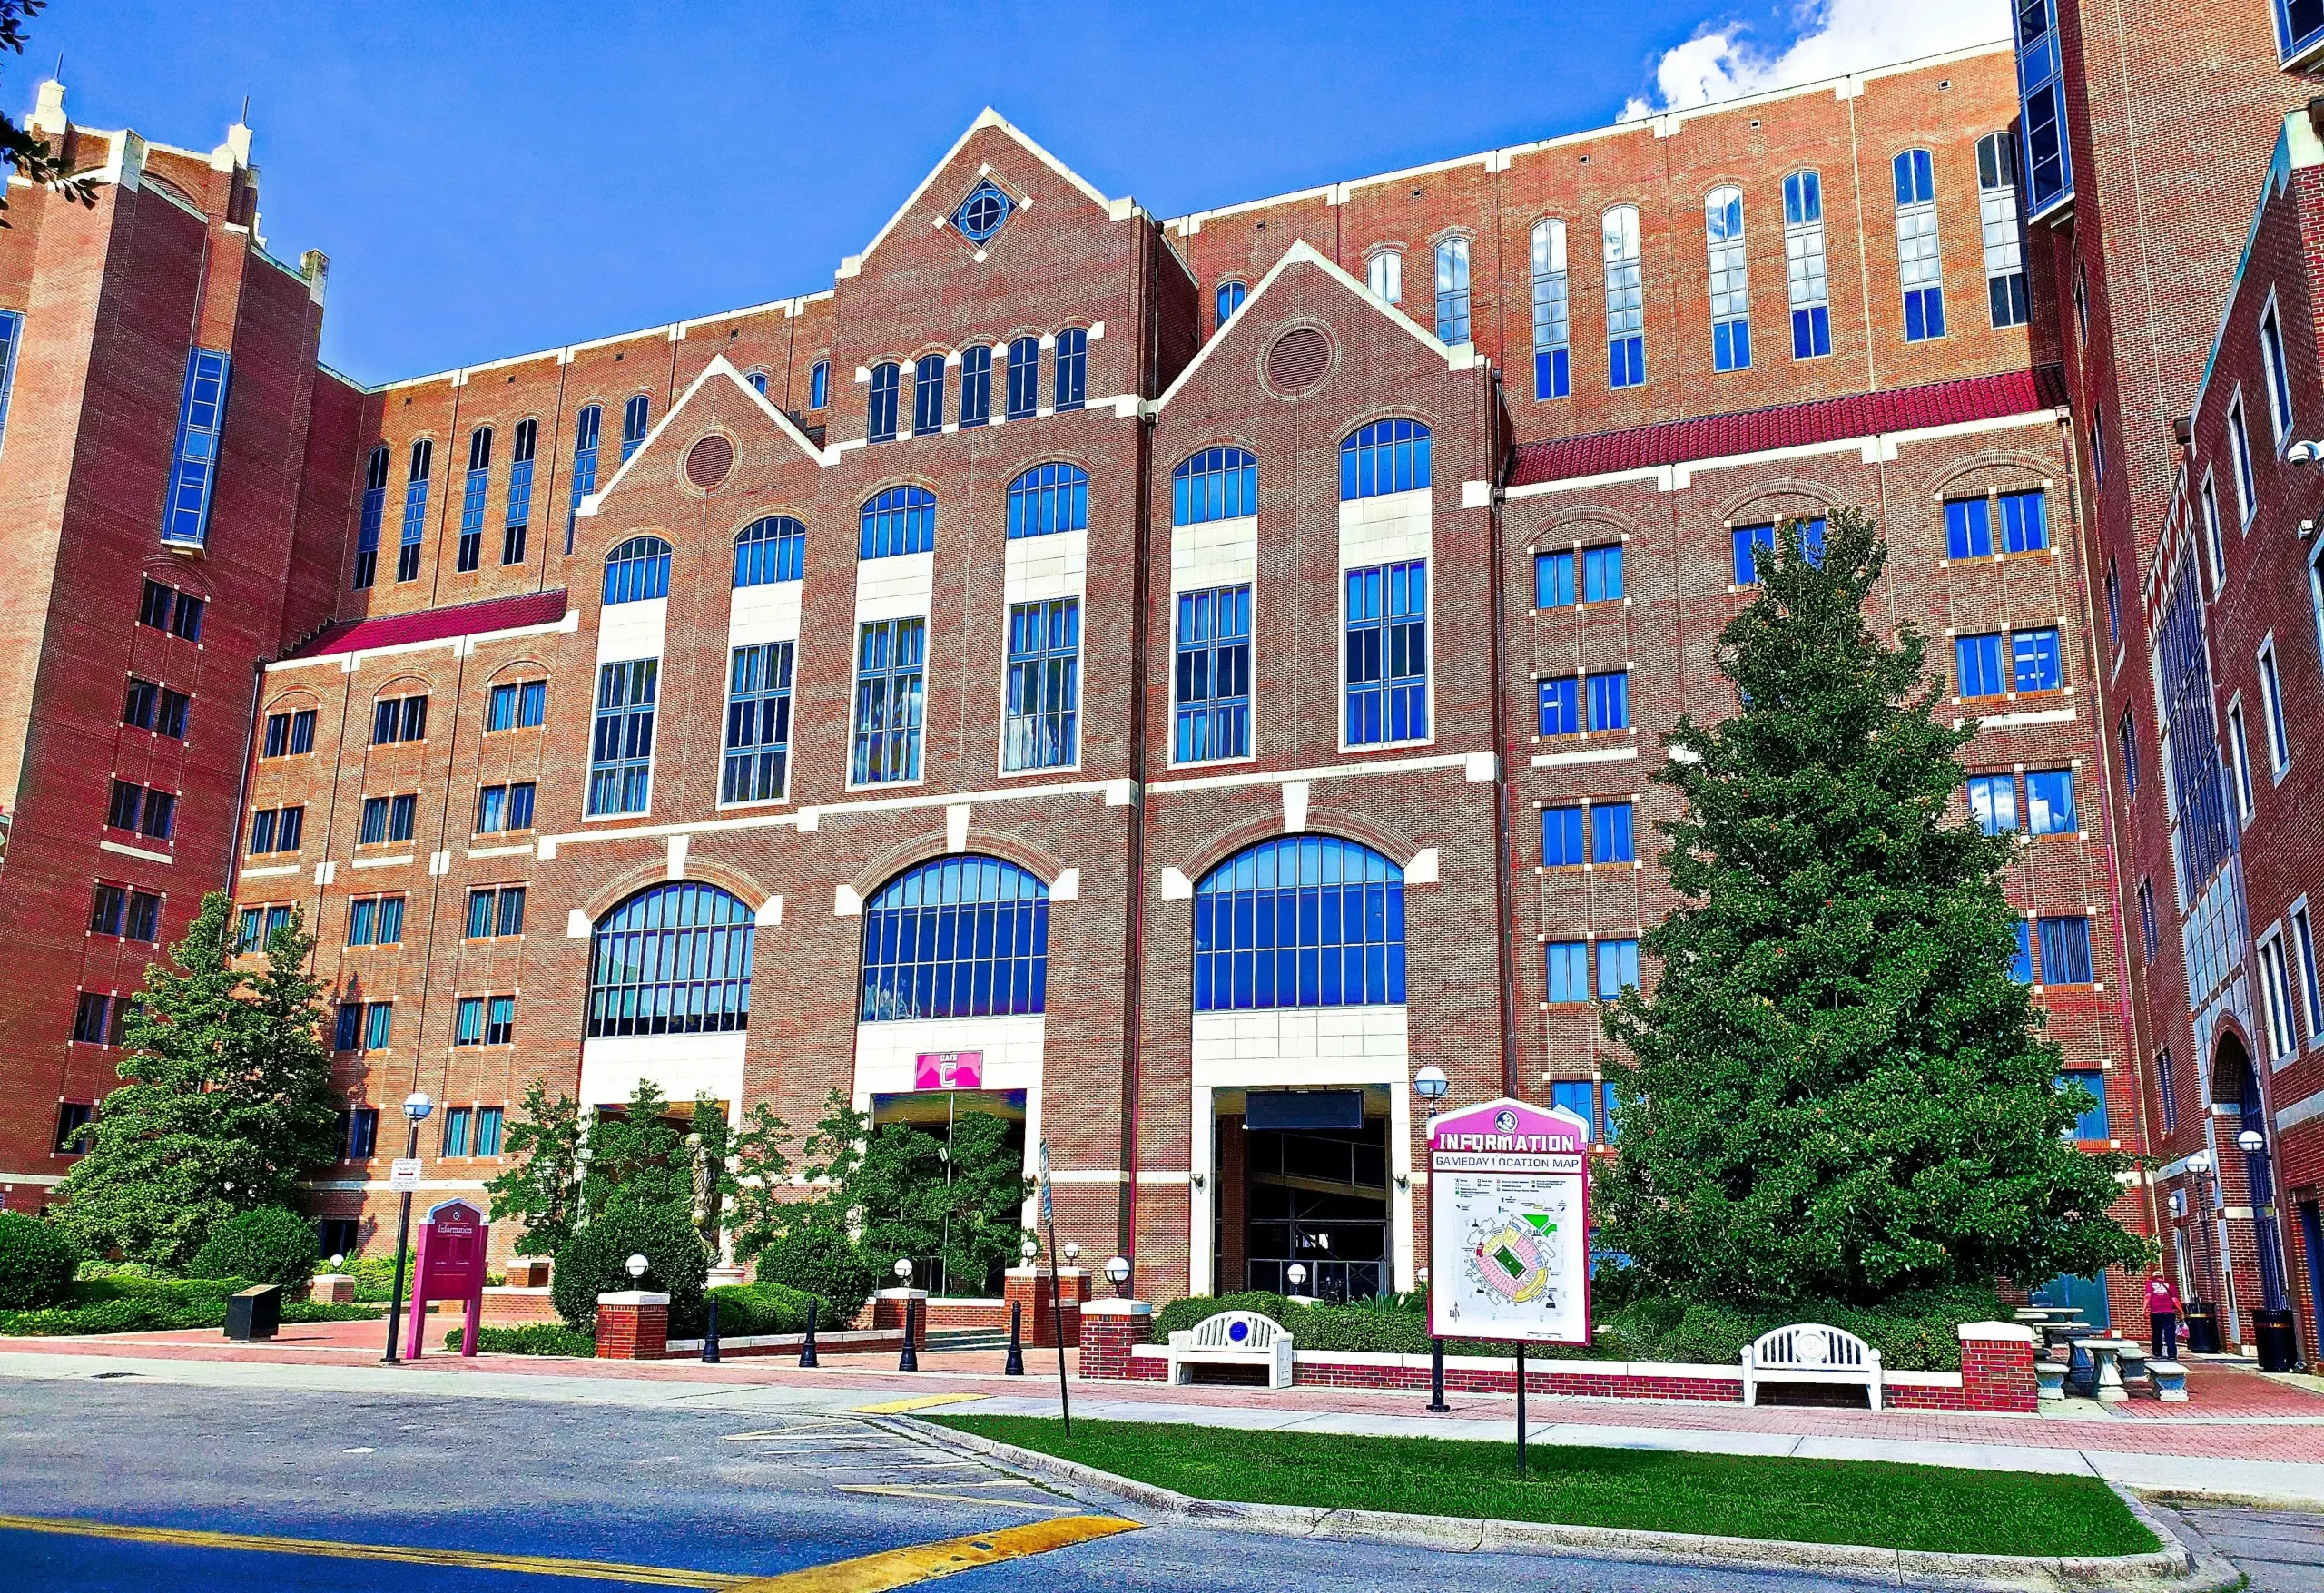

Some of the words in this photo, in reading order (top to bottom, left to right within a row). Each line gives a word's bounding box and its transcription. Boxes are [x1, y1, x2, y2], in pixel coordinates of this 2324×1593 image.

[940, 1054, 958, 1062] GATE
[940, 1062, 958, 1087] C
[1439, 1133, 1575, 1152] INFORMATION
[1436, 1155, 1490, 1166] GAMEDAY
[1492, 1157, 1549, 1167] LOCATION
[1552, 1158, 1579, 1168] MAP
[438, 1224, 472, 1234] Information
